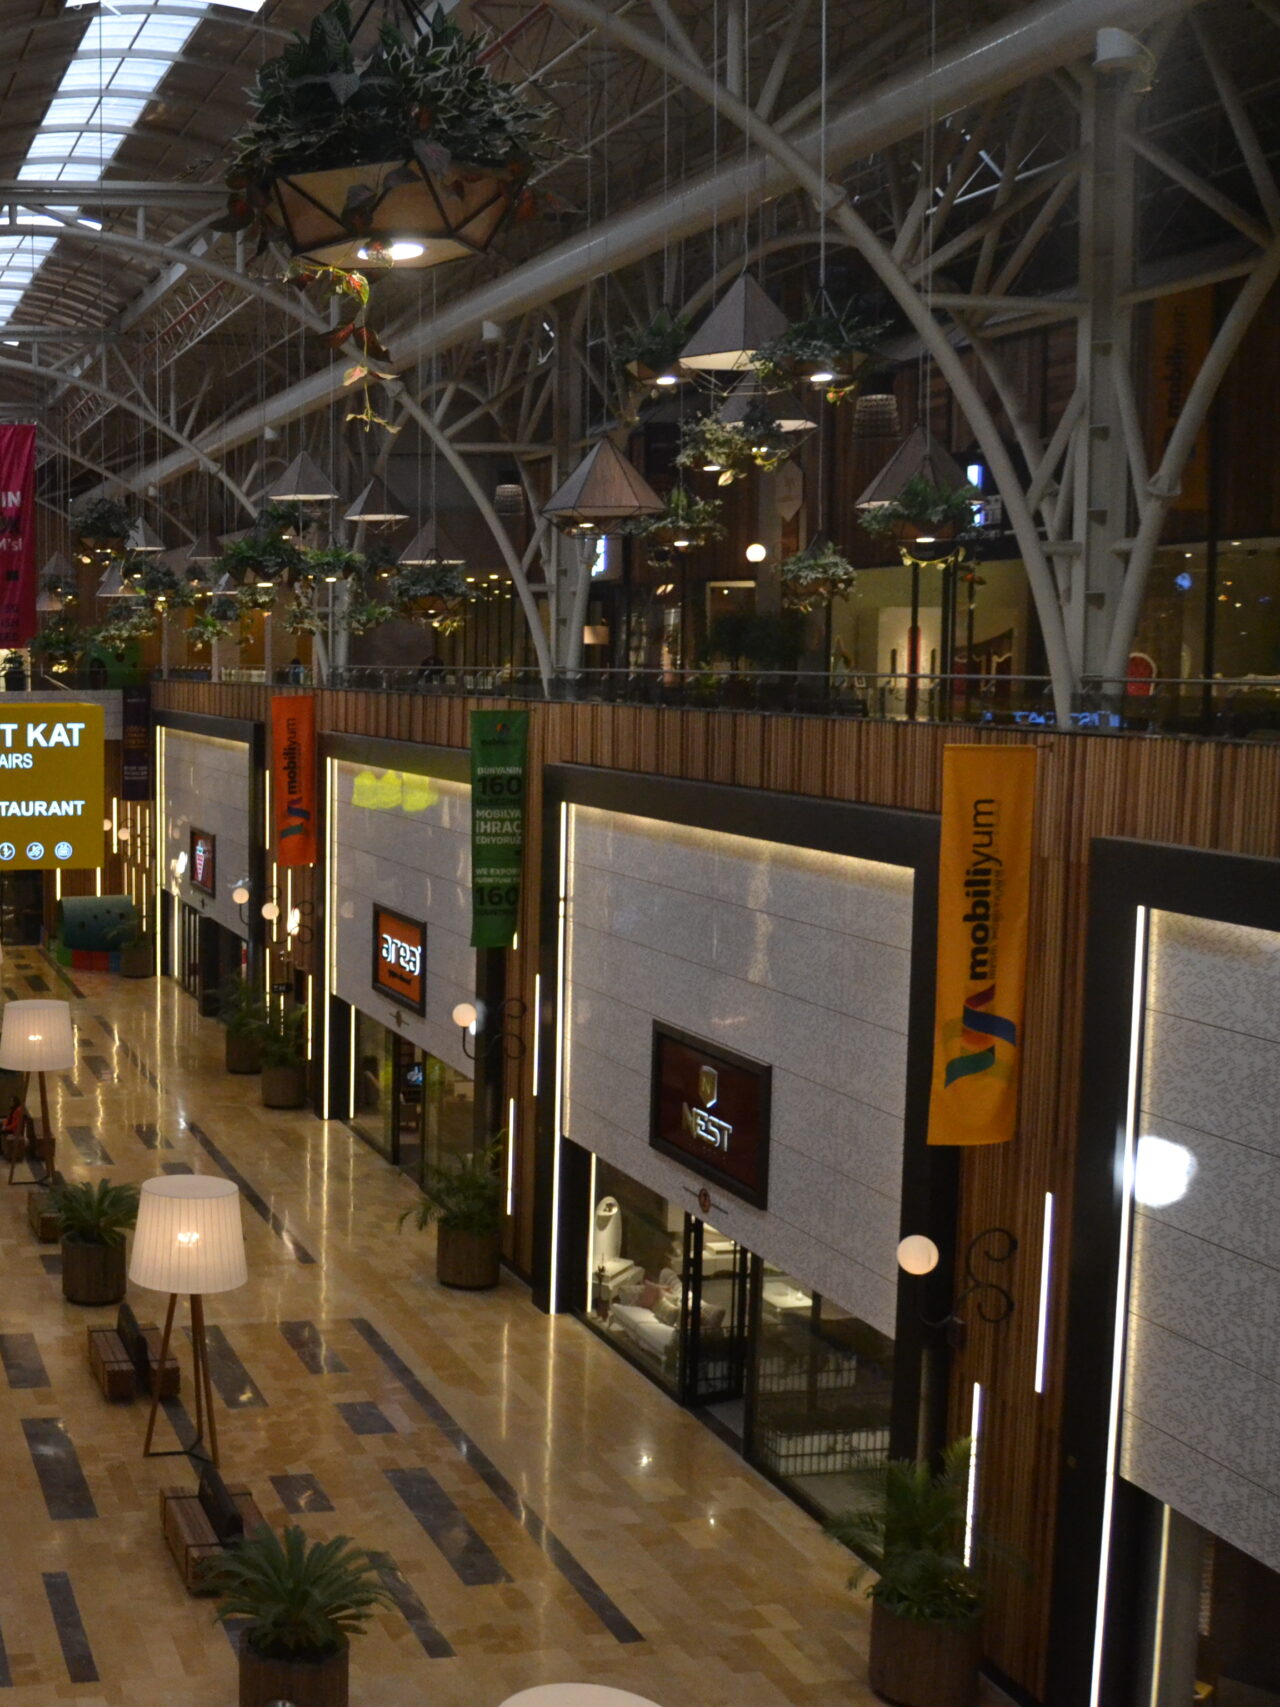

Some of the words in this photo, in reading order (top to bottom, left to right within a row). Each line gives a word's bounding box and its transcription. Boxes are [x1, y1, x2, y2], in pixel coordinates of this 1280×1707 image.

[26, 722, 86, 747] KAT
[283, 717, 299, 795] mobiliyum
[477, 776, 523, 796] 160
[476, 886, 519, 906] 160
[964, 798, 1002, 981] mobiliyum
[381, 933, 422, 977] area
